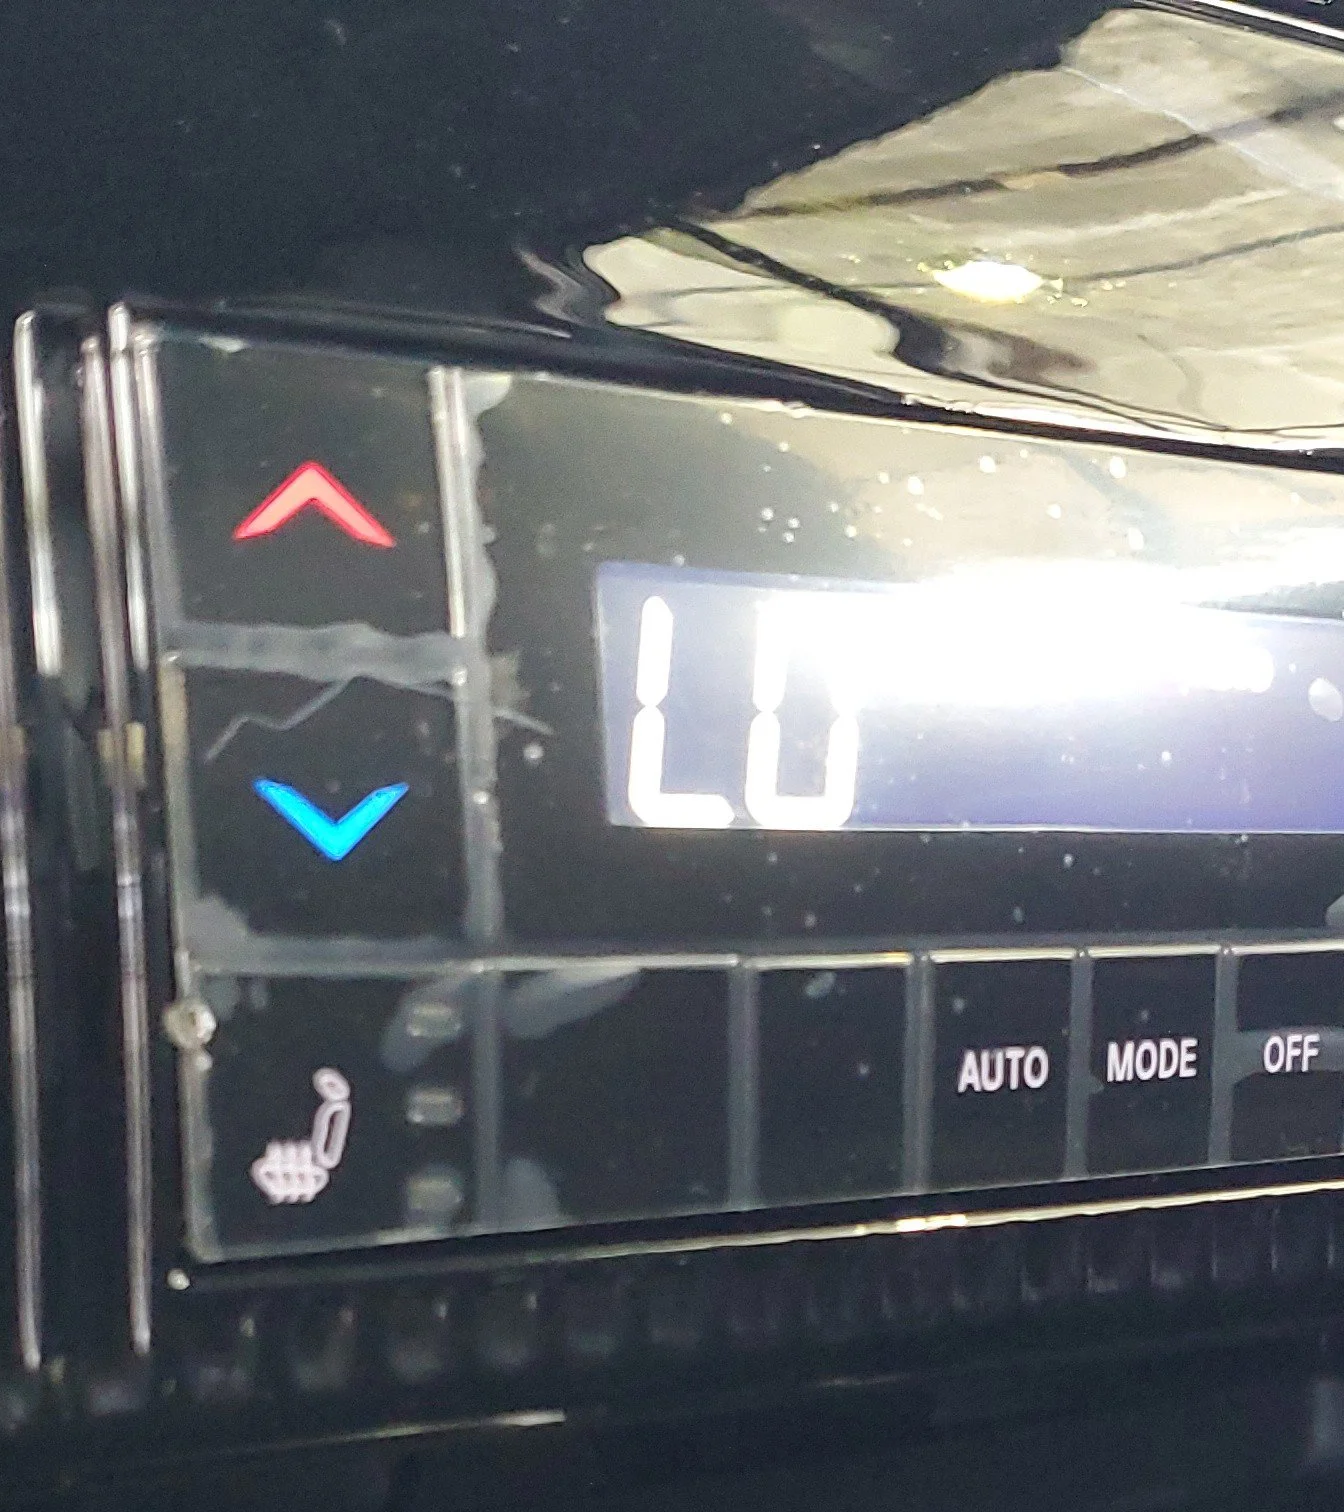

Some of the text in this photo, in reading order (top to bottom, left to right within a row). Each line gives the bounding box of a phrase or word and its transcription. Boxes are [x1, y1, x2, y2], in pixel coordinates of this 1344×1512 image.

[957, 1034, 1320, 1092] AUTO MODE OFF
